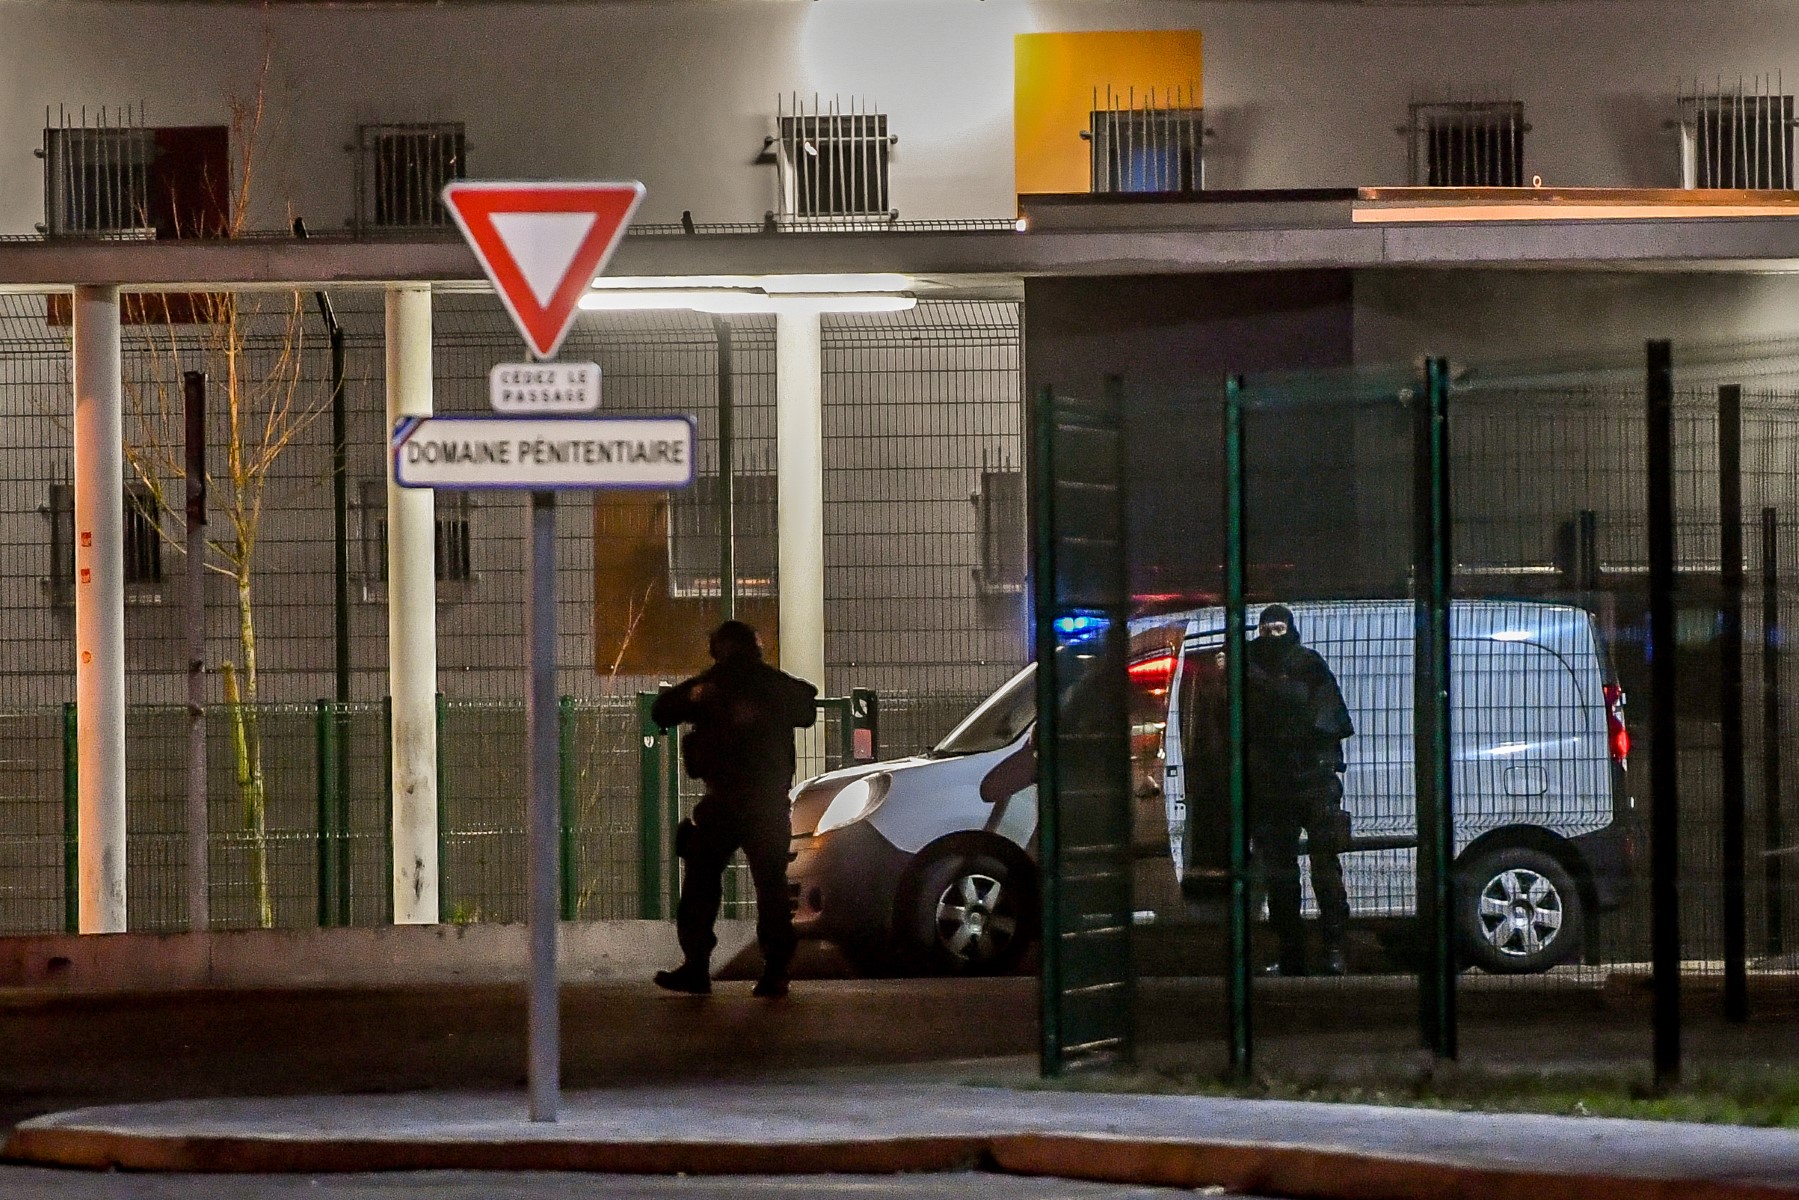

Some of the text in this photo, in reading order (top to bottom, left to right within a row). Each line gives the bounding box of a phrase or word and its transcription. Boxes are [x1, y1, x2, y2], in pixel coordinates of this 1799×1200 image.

[567, 369, 587, 384] LE
[502, 388, 587, 402] PASSAGE
[407, 434, 684, 464] DOMAINE PÉNITENTIAIRE
